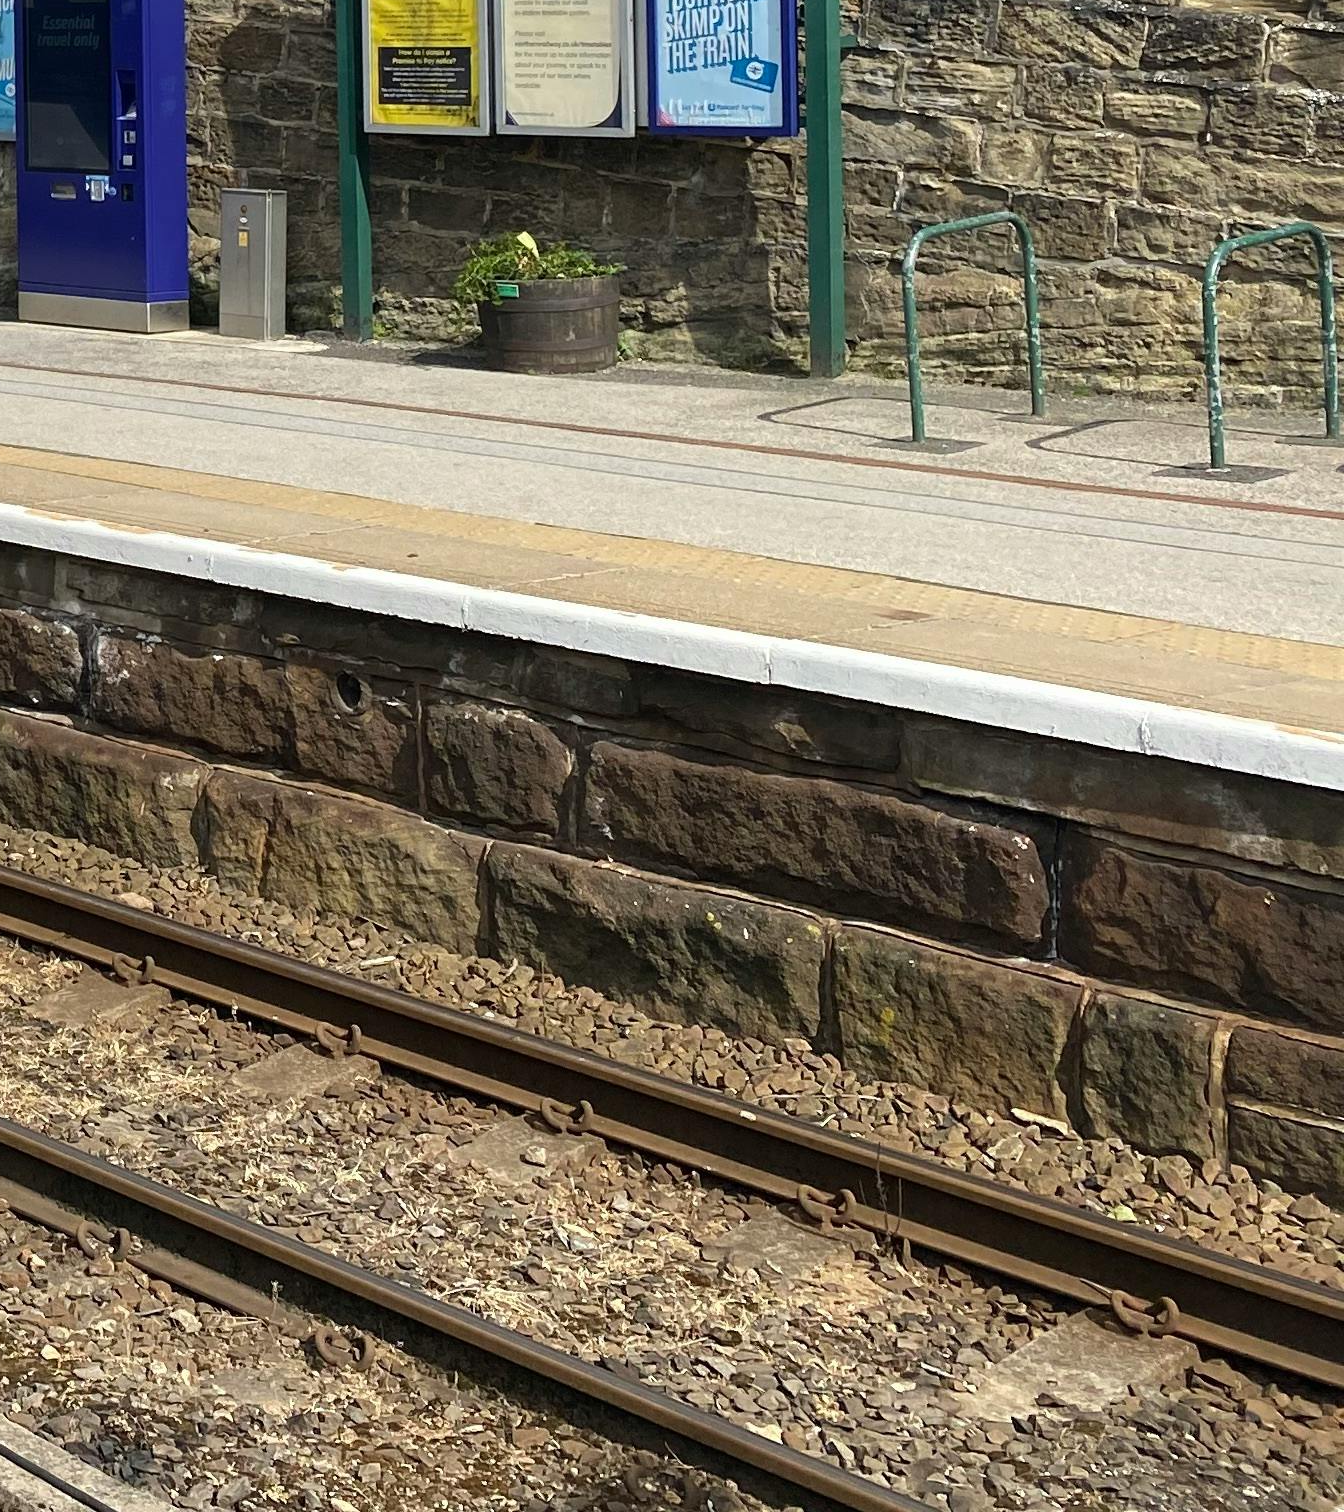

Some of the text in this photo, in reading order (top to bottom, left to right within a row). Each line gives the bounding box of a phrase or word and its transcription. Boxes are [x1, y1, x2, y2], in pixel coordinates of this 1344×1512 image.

[43, 14, 95, 30] Essential
[664, 0, 752, 42] SKIMP ON
[37, 31, 100, 50] travel only
[662, 38, 697, 73] THE
